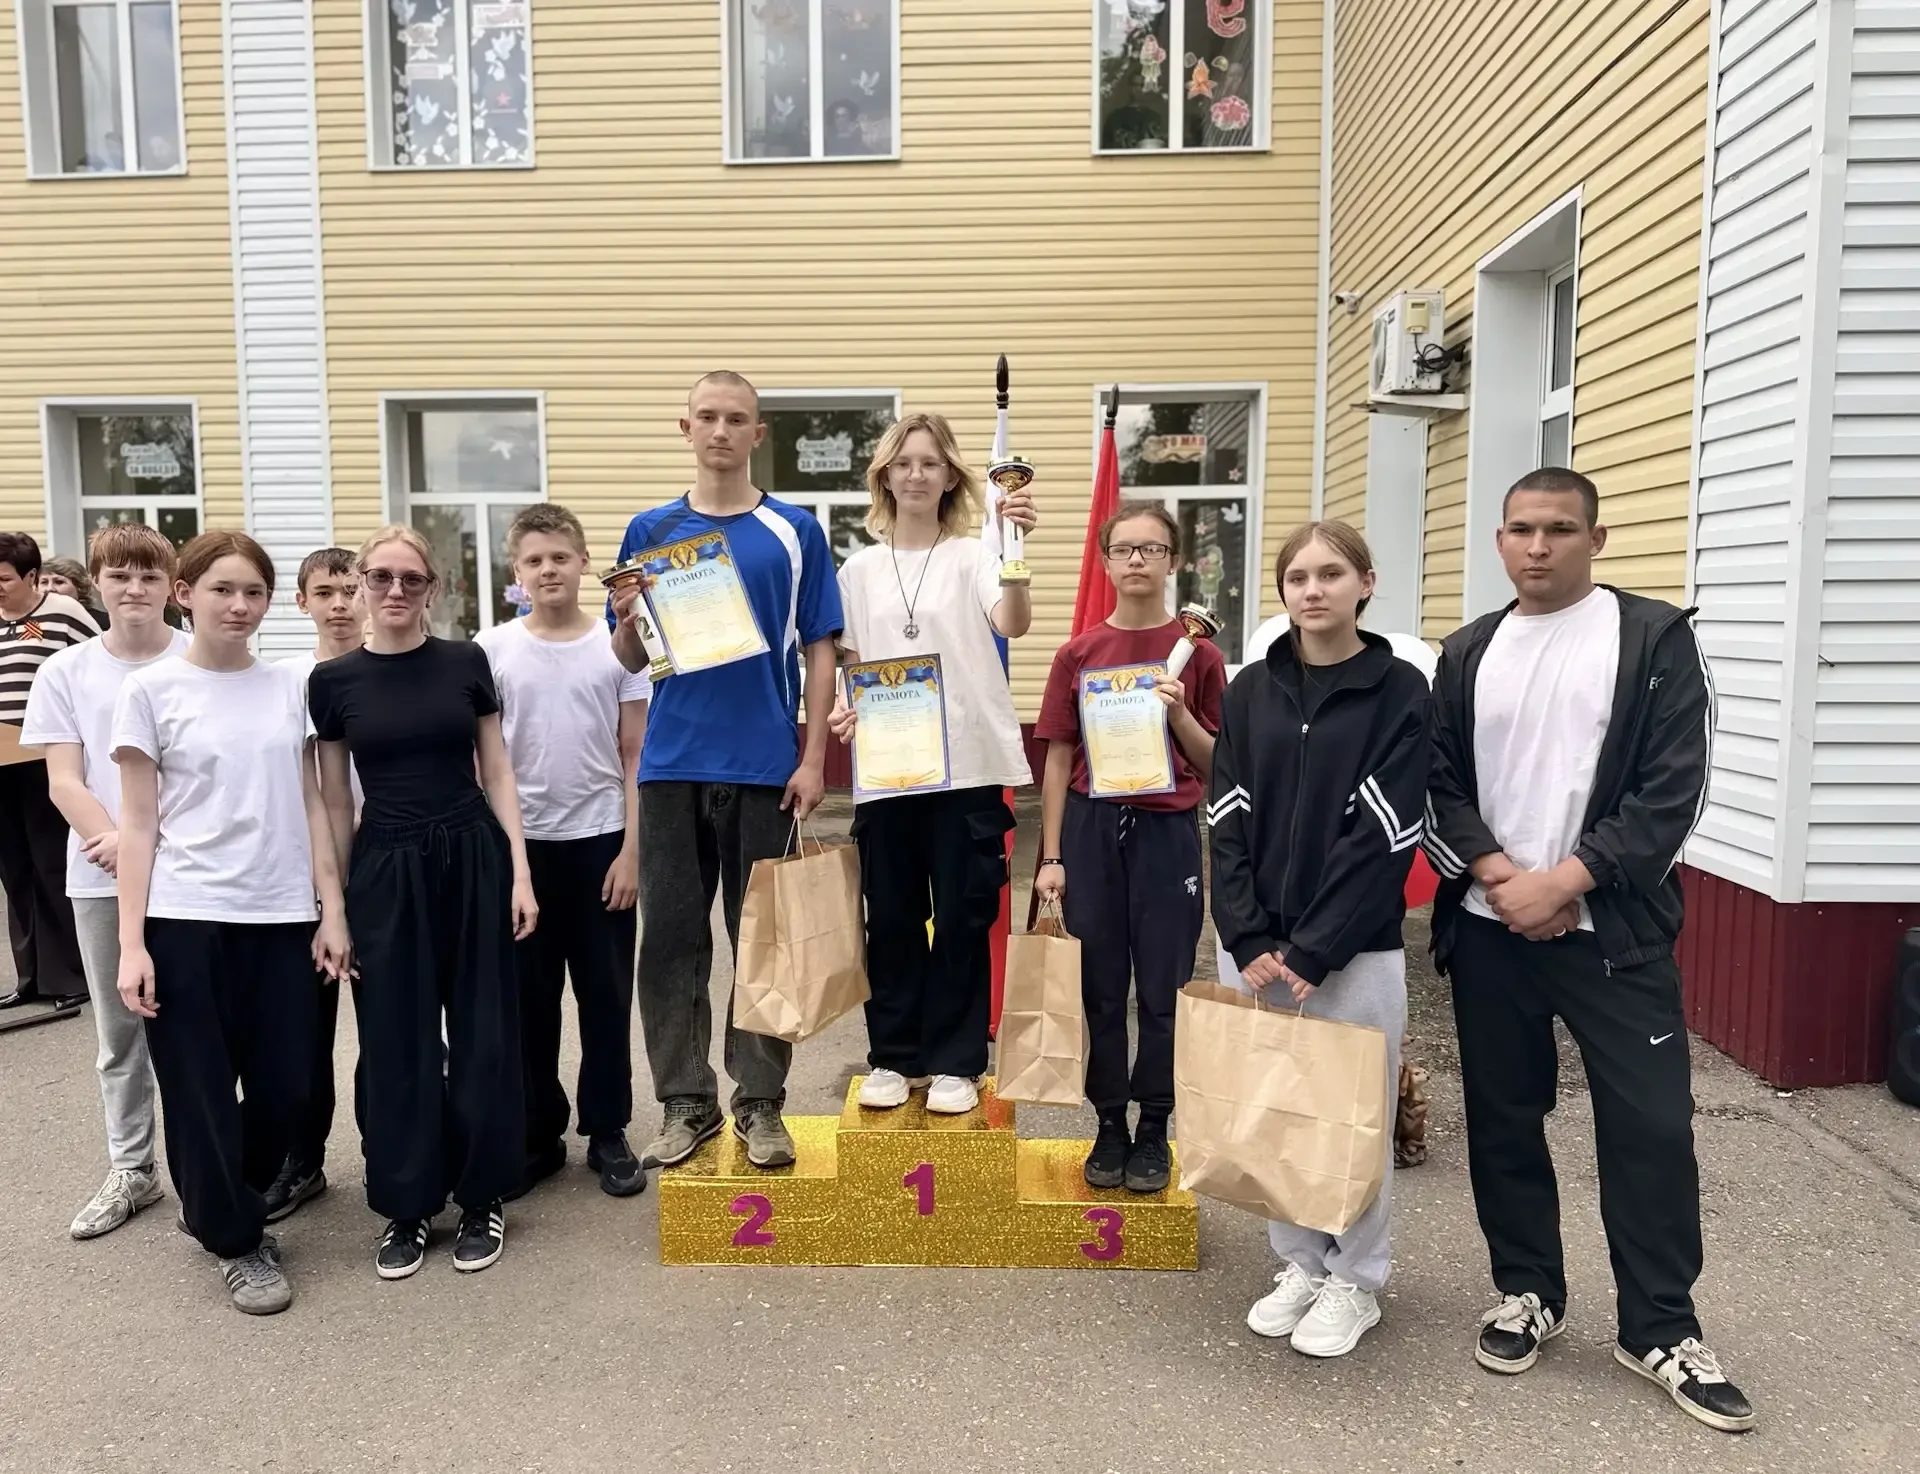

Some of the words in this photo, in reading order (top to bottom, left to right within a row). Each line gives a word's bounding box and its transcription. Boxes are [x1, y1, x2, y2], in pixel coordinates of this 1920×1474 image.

[666, 567, 716, 588] ГРАМОТА
[635, 616, 655, 640] 2
[871, 689, 921, 702] ГРАМОТА
[1100, 695, 1145, 708] ГРАМОТА
[903, 1162, 936, 1217] 1
[728, 1192, 776, 1248] 2
[1079, 1207, 1124, 1262] 3
